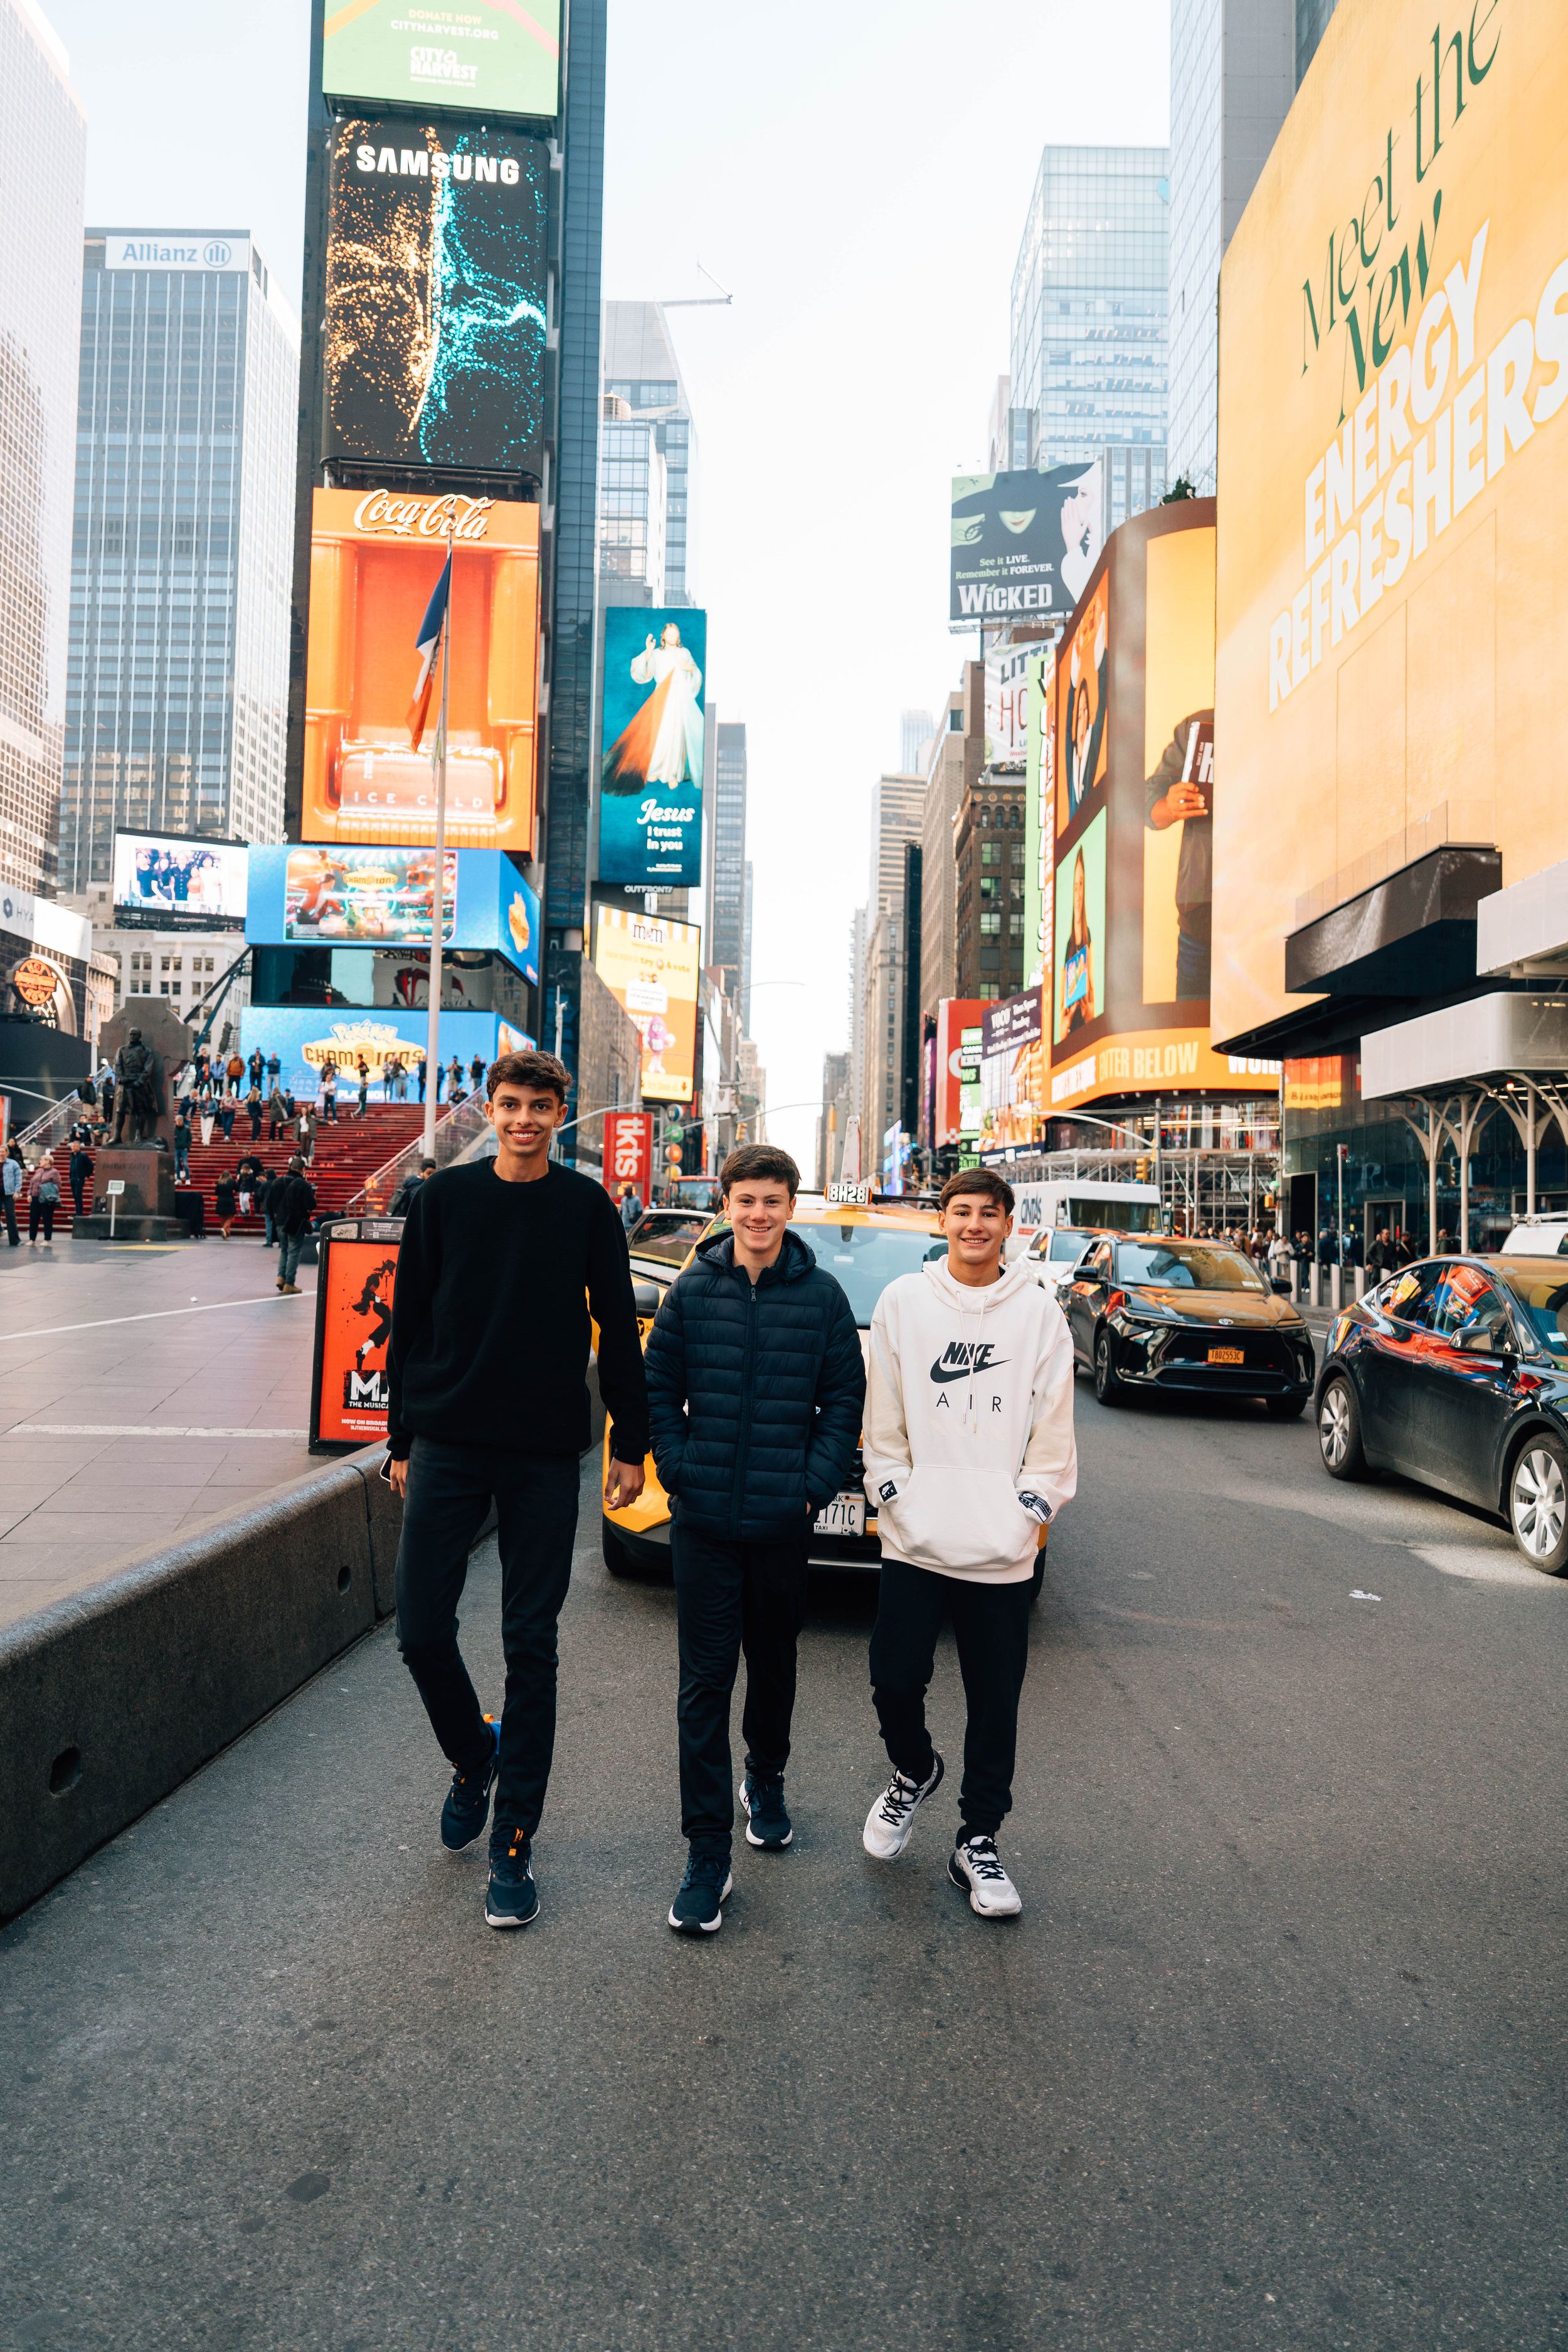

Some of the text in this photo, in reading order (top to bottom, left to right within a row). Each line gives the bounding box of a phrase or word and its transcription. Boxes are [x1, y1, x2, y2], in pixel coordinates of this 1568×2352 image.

[408, 9, 482, 25] DONATE NOW
[390, 19, 499, 41] CITYHARVEST.ORG
[410, 45, 445, 61] CITY
[410, 59, 478, 81] HARVEST
[356, 144, 520, 185] SAMSUNG
[1301, 0, 1503, 379] Meet the
[122, 243, 198, 262] Allianz
[1336, 188, 1442, 429] New
[1305, 217, 1490, 573] ENERGY
[1269, 257, 1568, 715] REFRESHERS
[979, 558, 996, 566] See
[997, 556, 1004, 565] it
[955, 568, 1001, 580] Remember
[1002, 567, 1009, 576] it
[354, 791, 483, 808] ICE CLD
[637, 798, 696, 825] Jesus
[647, 825, 682, 837] I trust
[647, 838, 683, 852] in you
[1133, 1041, 1199, 1079] BELOW
[615, 1116, 646, 1177] tkts
[829, 1185, 866, 1203] 8H28
[942, 1342, 995, 1366] NIKE
[936, 1391, 1002, 1413] AIR
[816, 1503, 856, 1526] 171C
